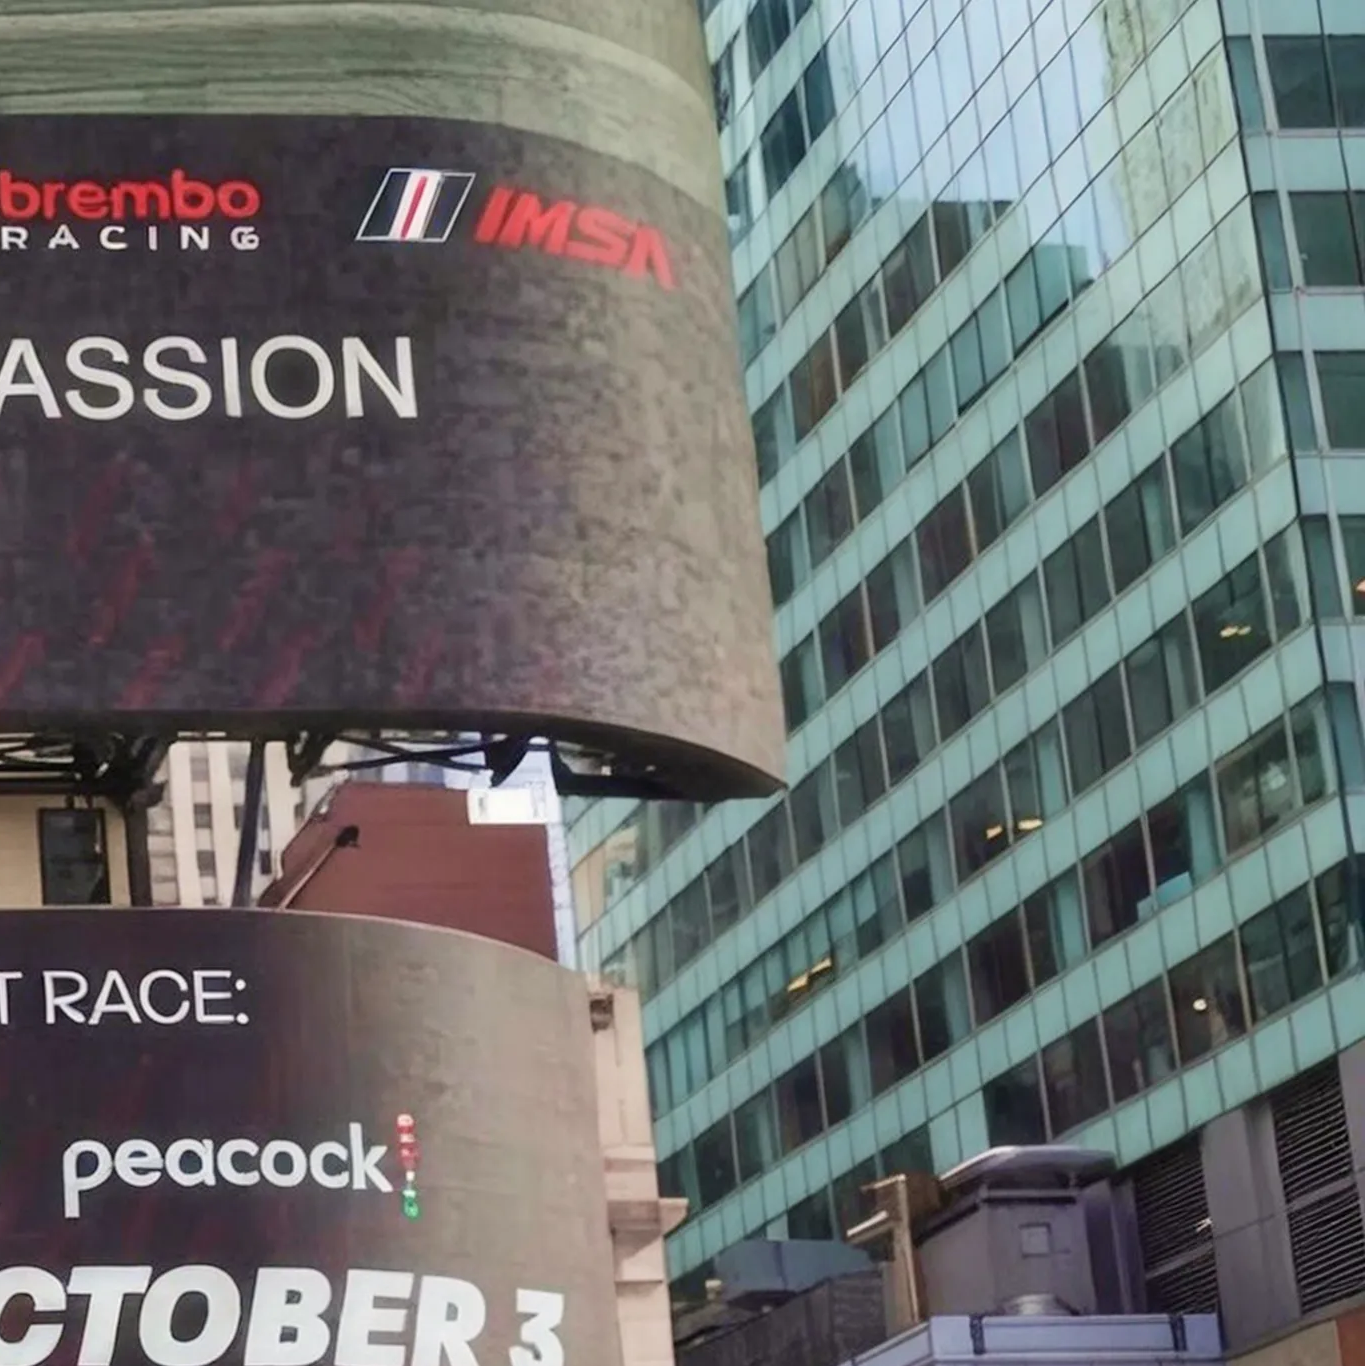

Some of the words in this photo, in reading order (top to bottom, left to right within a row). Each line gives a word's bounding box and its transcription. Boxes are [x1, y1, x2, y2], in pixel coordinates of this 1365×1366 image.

[0, 225, 259, 251] RACING
[475, 186, 678, 290] IMSA
[43, 968, 250, 1025] RACE:
[62, 1121, 394, 1218] peacock
